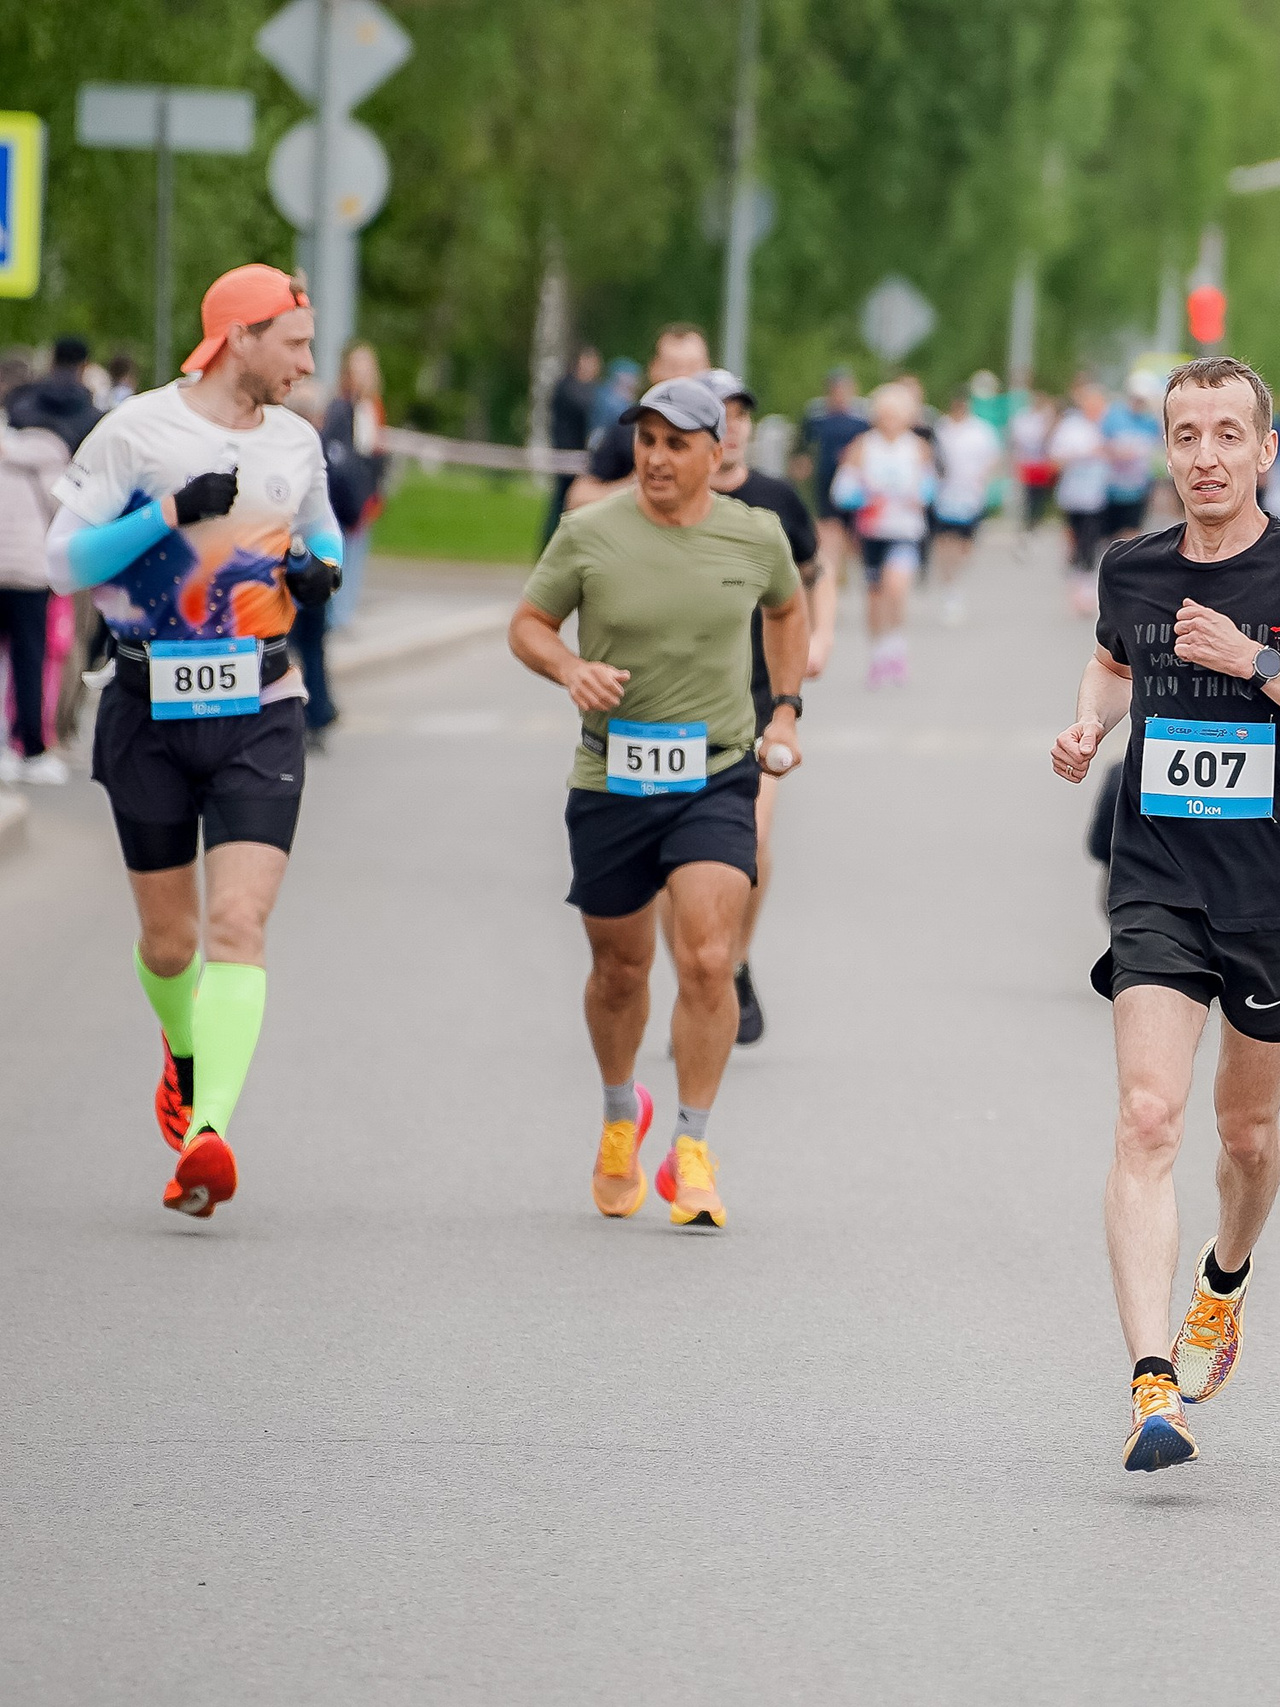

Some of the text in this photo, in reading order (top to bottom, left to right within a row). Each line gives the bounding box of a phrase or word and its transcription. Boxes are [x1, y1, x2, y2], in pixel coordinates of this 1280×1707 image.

[1134, 623, 1171, 644] YOU
[175, 663, 236, 693] 805
[1143, 676, 1179, 697] YOU
[626, 745, 686, 773] 510
[1167, 749, 1247, 789] 607
